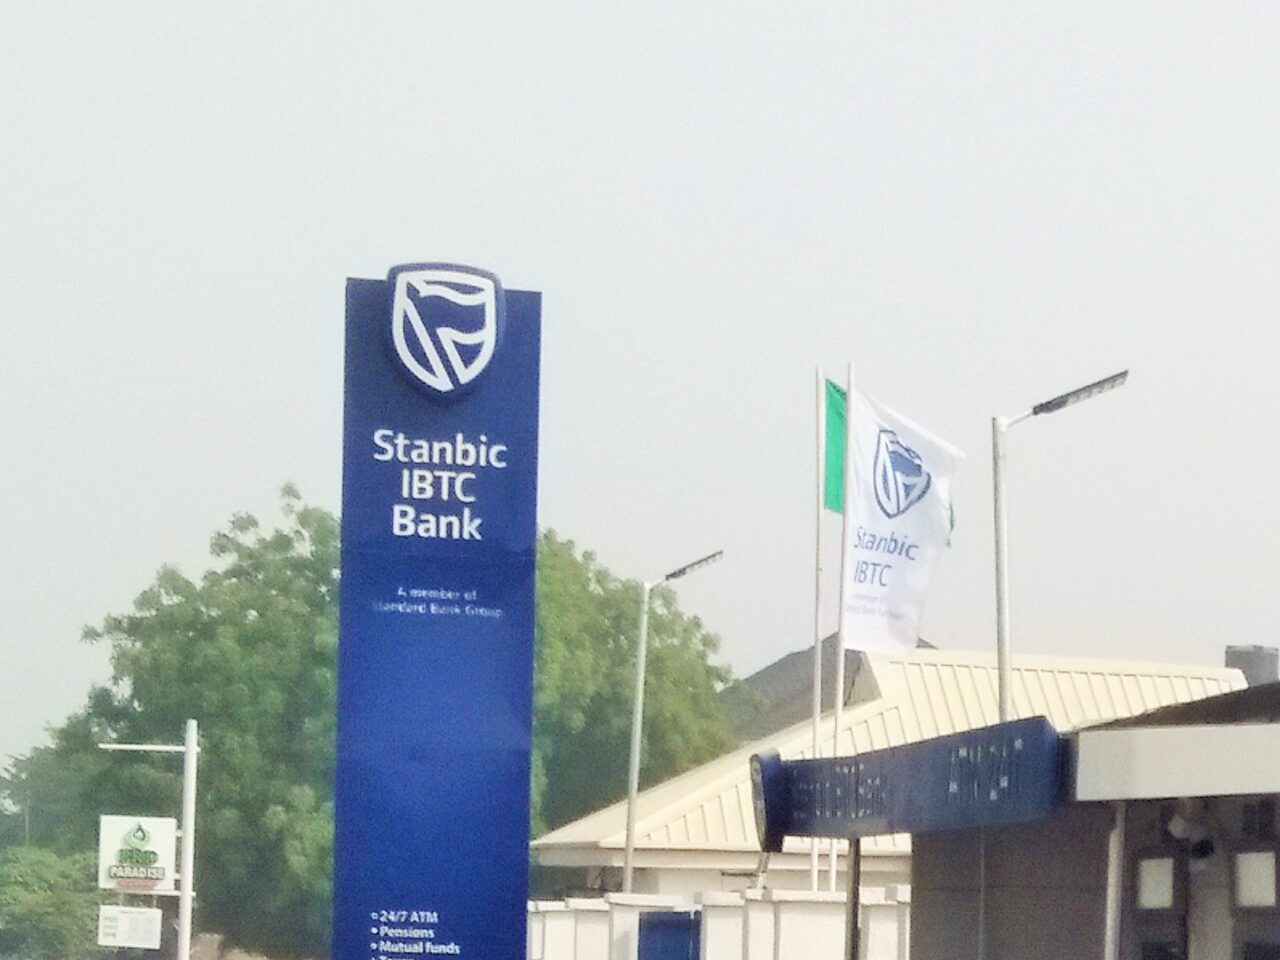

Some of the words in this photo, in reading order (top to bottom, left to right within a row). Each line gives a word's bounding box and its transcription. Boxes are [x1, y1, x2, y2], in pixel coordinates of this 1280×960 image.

[373, 429, 508, 468] Stanbic
[402, 469, 476, 503] IBTC
[393, 504, 483, 540] Bank
[854, 526, 919, 560] Stanbic
[854, 561, 892, 587] IBTC
[379, 910, 408, 923] 24/7
[410, 911, 439, 924] ATM
[379, 927, 436, 939] Pensions
[379, 941, 424, 954] Mutual
[425, 942, 461, 955] funds
